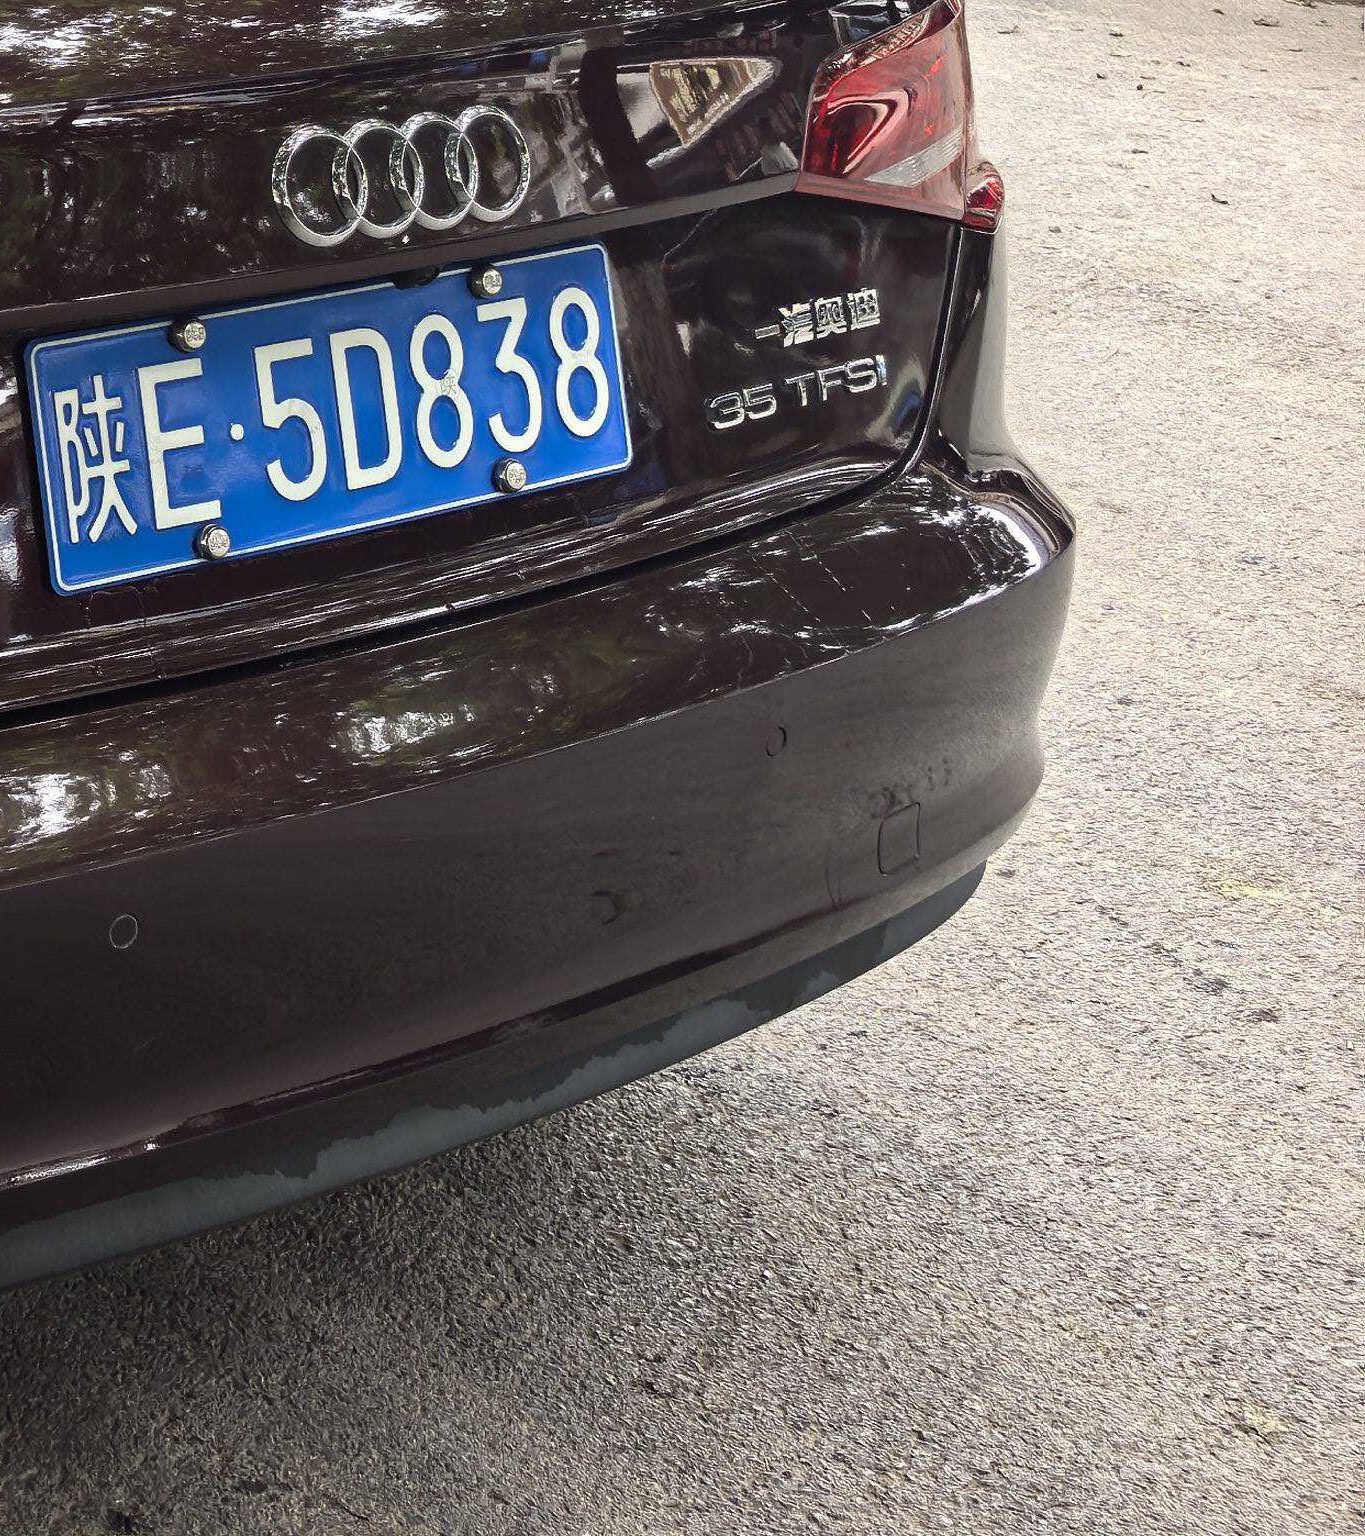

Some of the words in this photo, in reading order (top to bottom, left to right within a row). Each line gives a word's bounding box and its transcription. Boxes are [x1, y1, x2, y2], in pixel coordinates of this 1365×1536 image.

[754, 287, 881, 348] 一汽奥迪
[706, 382, 778, 431] 35
[784, 354, 888, 407] TFSI
